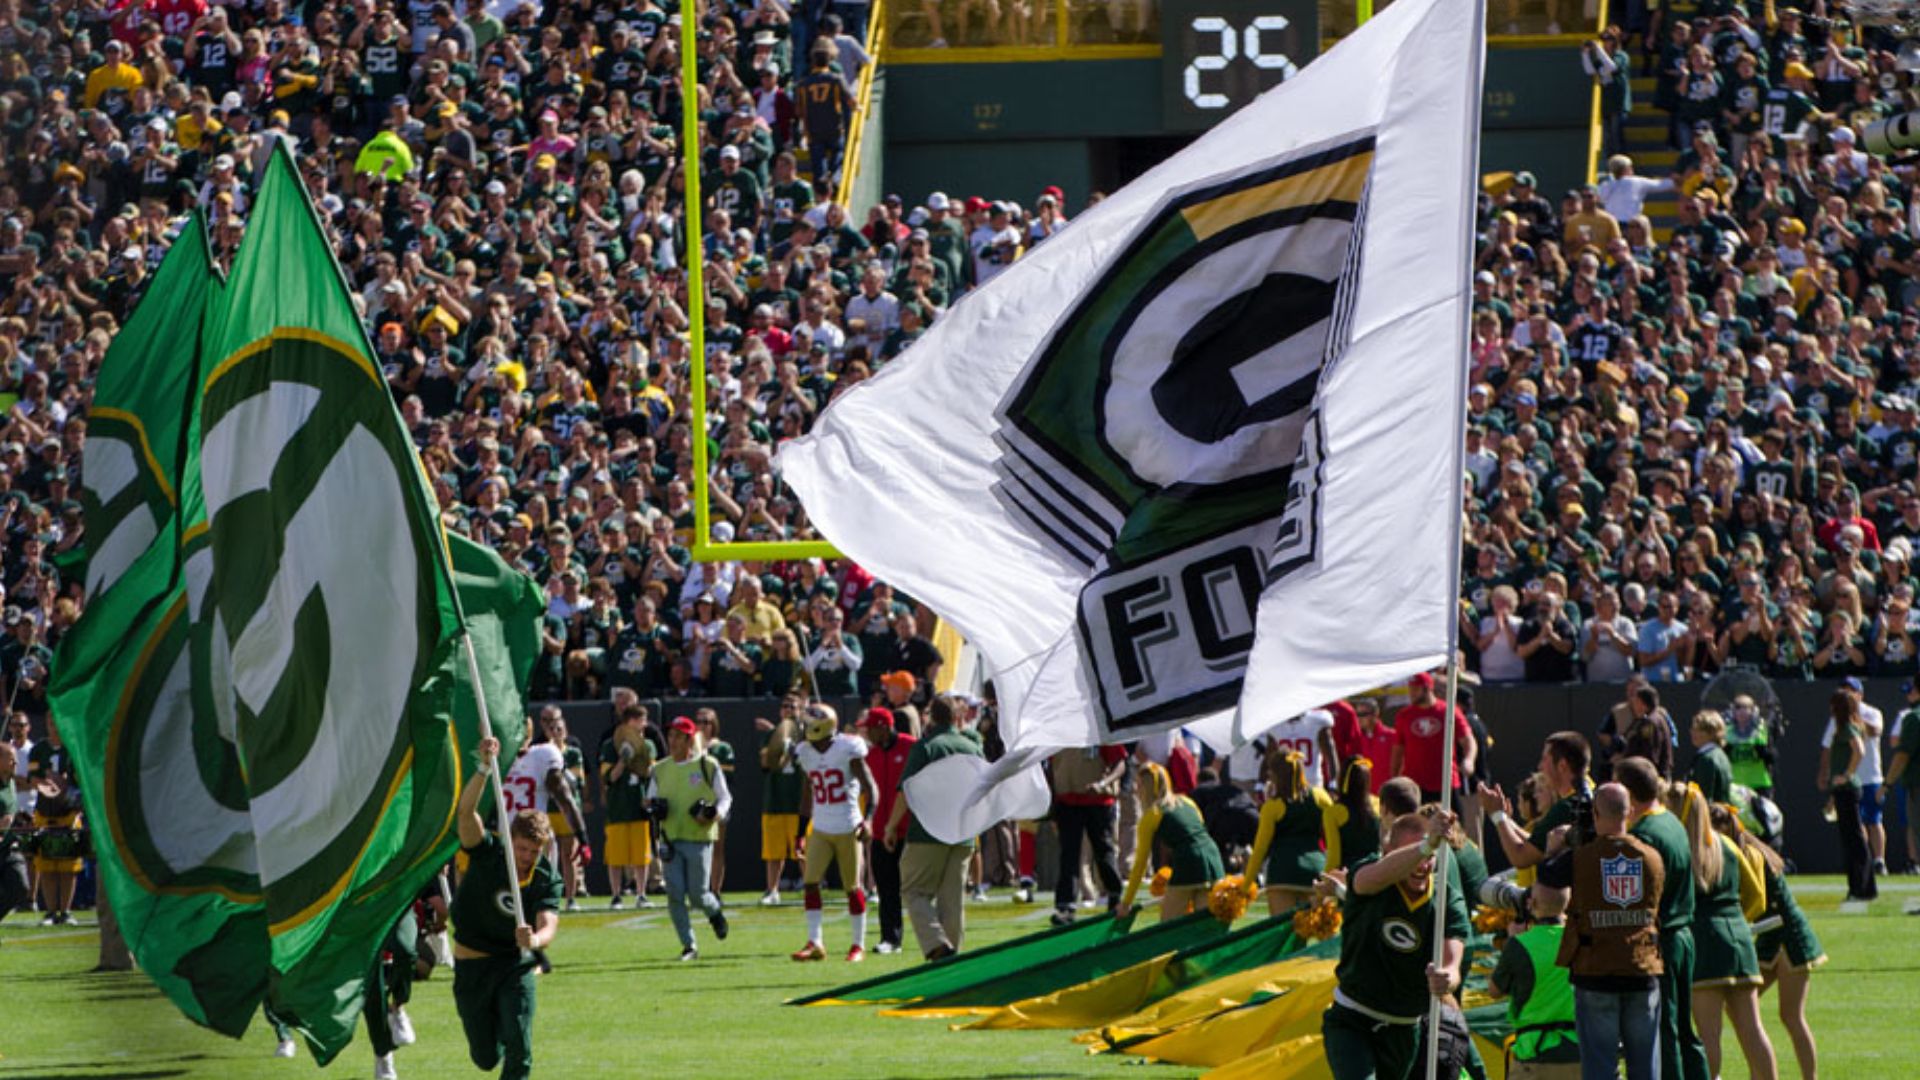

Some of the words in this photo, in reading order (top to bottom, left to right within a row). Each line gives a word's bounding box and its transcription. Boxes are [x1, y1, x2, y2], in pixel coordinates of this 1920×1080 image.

[201, 43, 226, 68] 12
[366, 46, 398, 73] 52
[1184, 16, 1299, 108] 25
[809, 83, 831, 103] 17
[1763, 104, 1786, 134] 12
[716, 187, 741, 215] 12
[1582, 334, 1609, 360] 12
[1756, 471, 1787, 498] 80
[809, 769, 847, 804] 82
[1608, 876, 1638, 899] NFL
[1382, 919, 1421, 951] G
